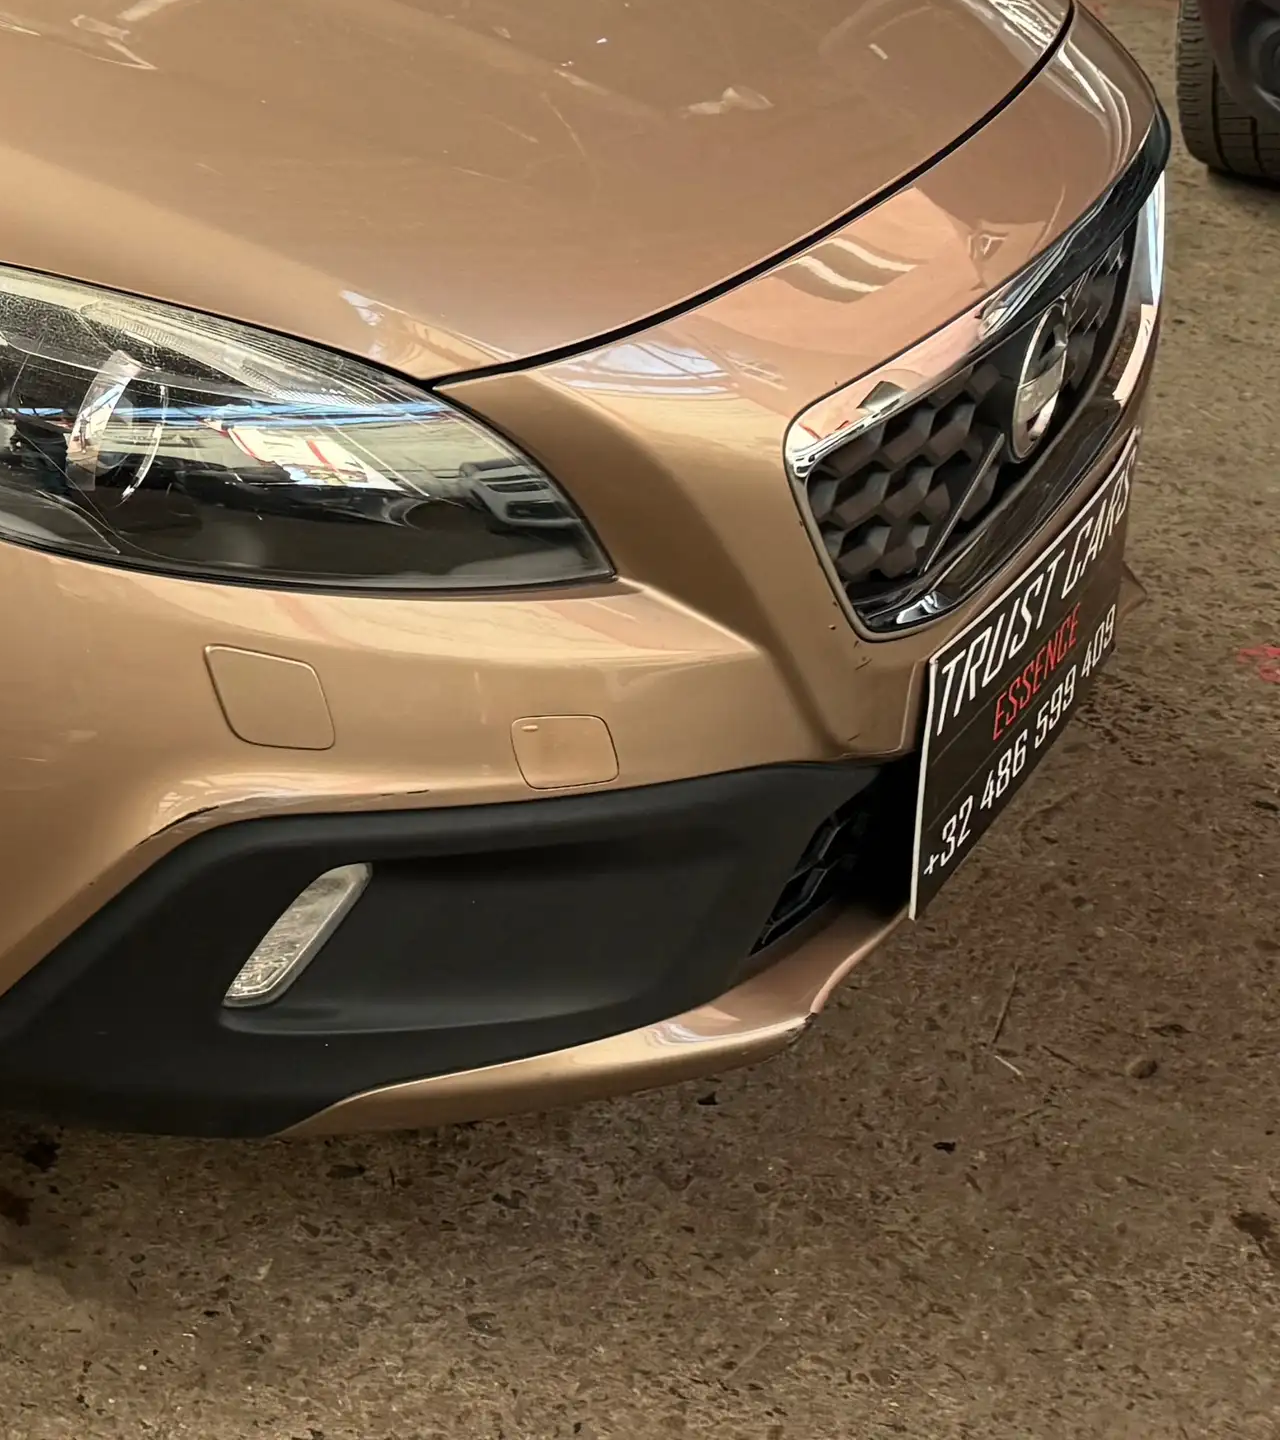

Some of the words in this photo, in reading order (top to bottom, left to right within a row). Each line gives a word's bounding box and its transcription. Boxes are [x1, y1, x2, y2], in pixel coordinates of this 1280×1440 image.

[936, 549, 1066, 737] TRUST
[1061, 445, 1137, 599] CARS
[993, 602, 1081, 741] ESSENCE
[923, 795, 973, 876] +32
[980, 728, 1028, 810] 486
[1035, 664, 1077, 750] 599
[1081, 603, 1116, 678] 409
